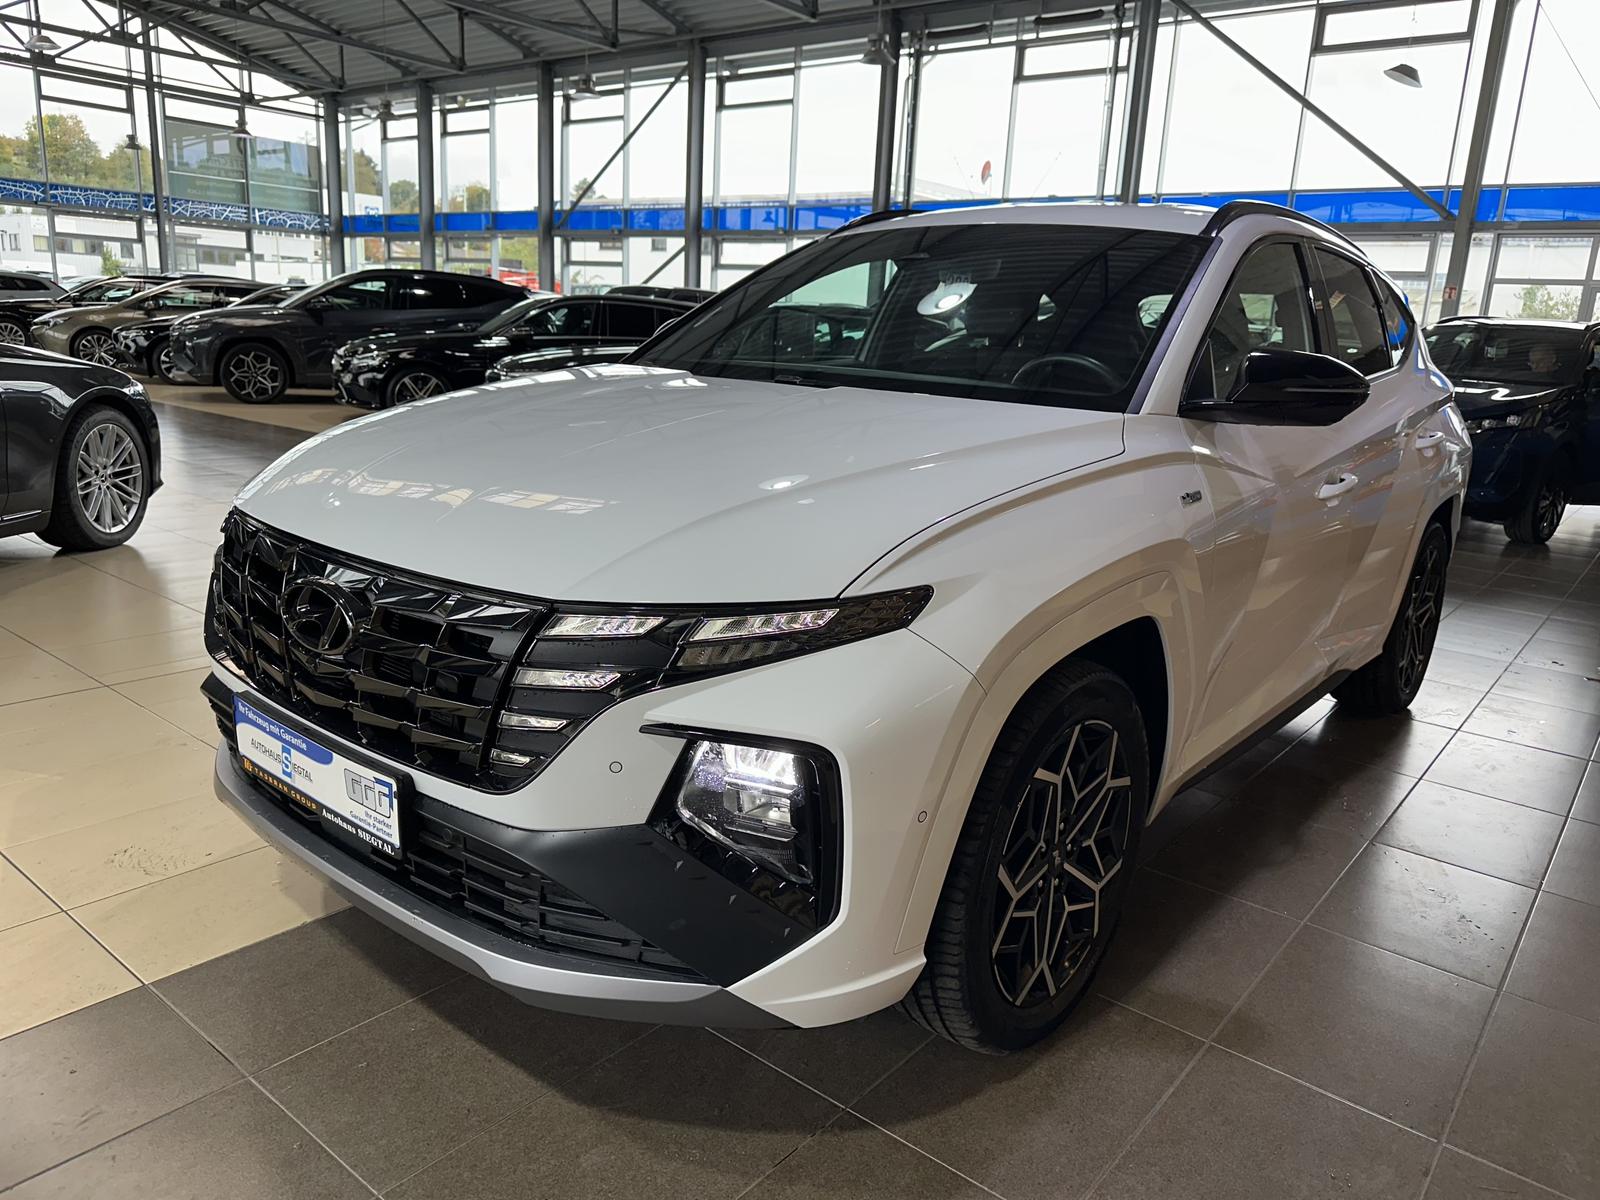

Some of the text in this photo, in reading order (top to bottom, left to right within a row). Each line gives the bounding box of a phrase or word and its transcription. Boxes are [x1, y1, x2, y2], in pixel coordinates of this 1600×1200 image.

[246, 707, 269, 731] Fahrzeug
[270, 723, 280, 736] mit
[280, 728, 307, 751] Garantie
[250, 737, 313, 782] AUTOHAUS SIEGTAL
[322, 808, 395, 856] Autohaus SIEGTAL
